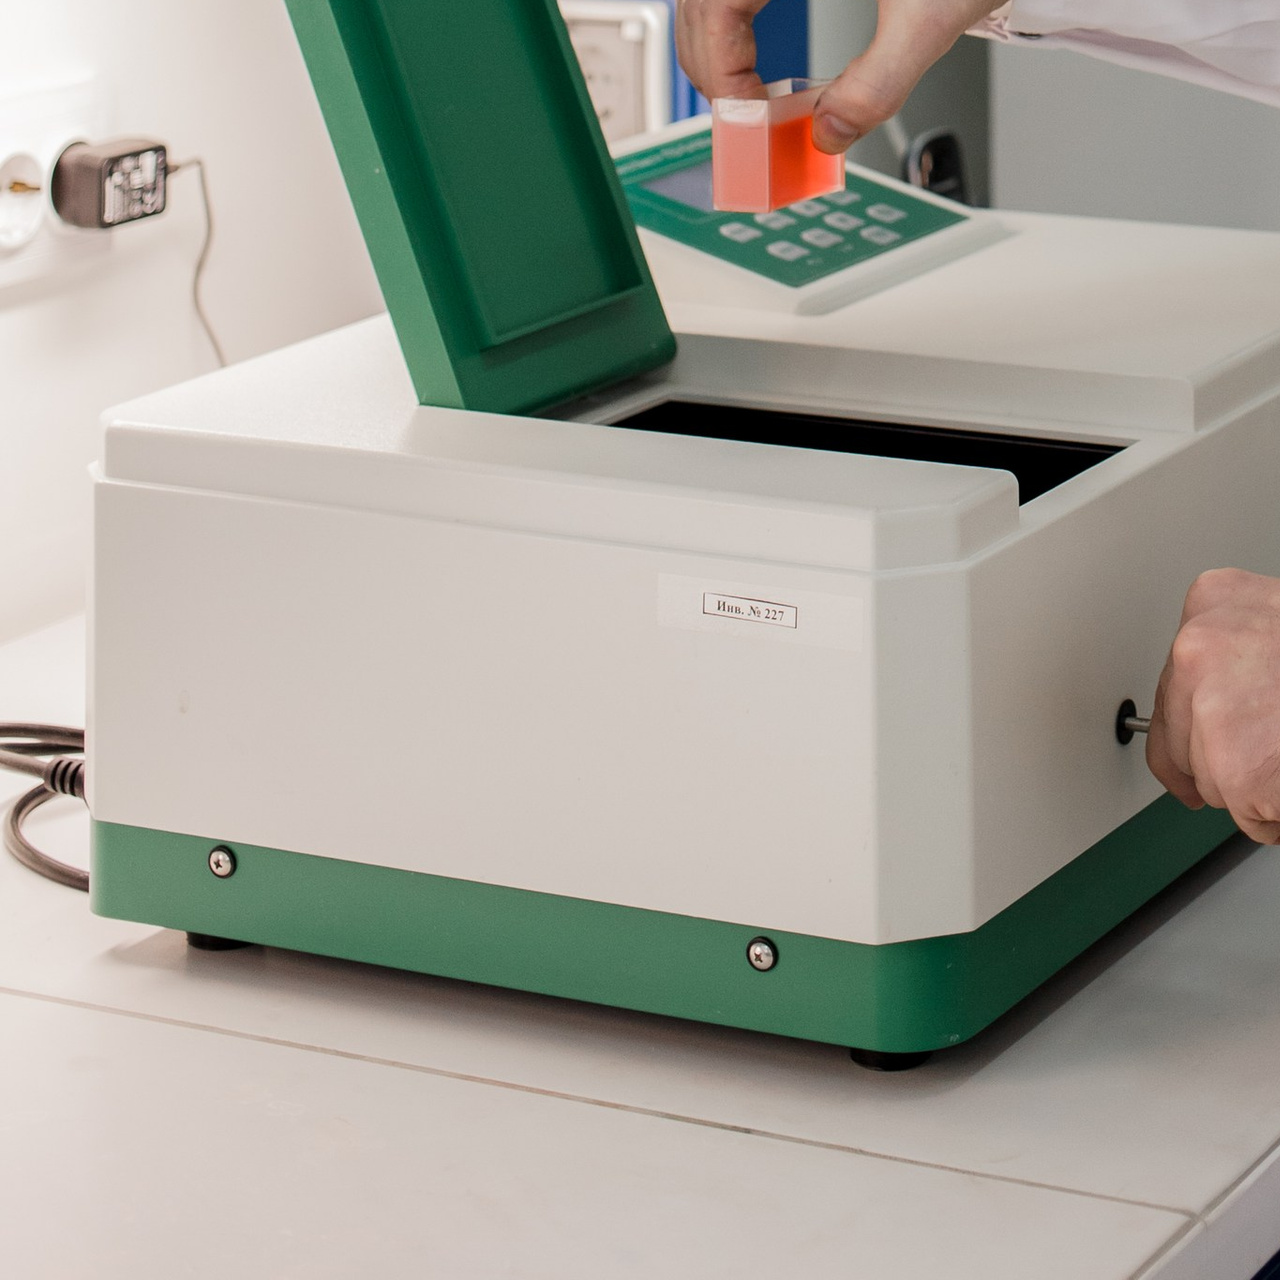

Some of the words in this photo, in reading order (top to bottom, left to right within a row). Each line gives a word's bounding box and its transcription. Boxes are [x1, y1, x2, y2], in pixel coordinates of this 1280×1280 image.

[716, 600, 745, 615] Инв.
[748, 605, 762, 618] №
[764, 608, 785, 621] 227
